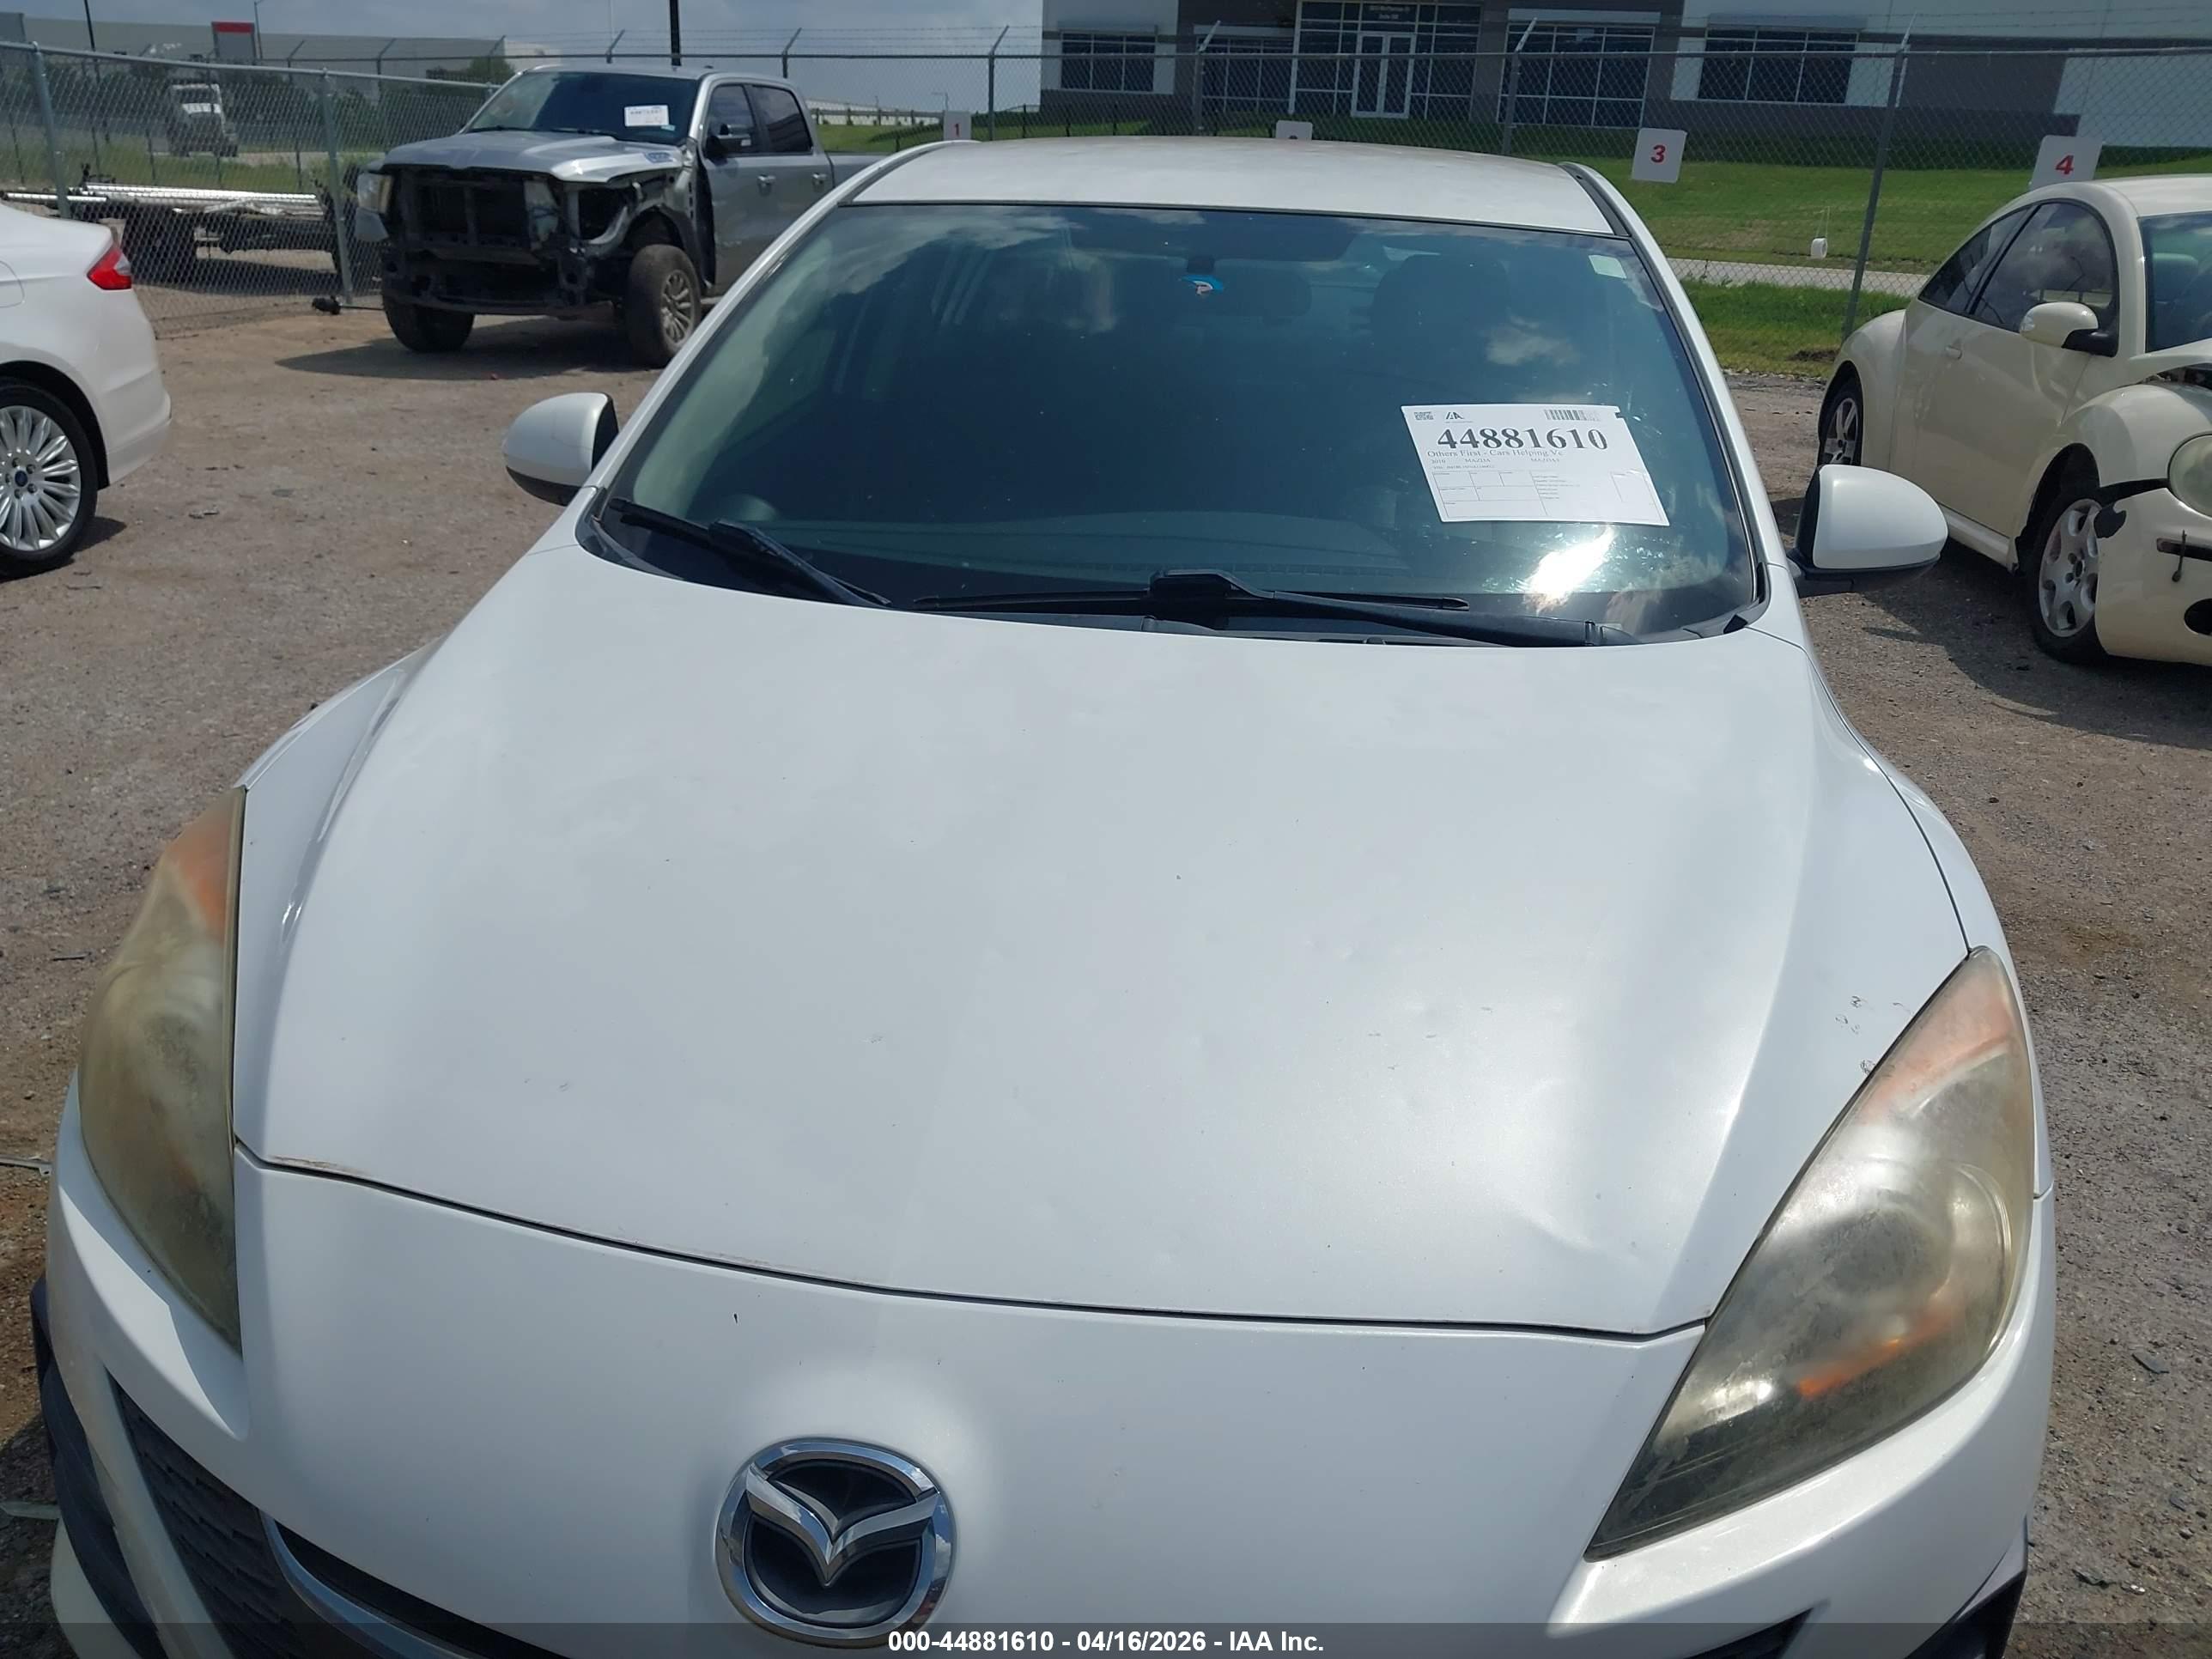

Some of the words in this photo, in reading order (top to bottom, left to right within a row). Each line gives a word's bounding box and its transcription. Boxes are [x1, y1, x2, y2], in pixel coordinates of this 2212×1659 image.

[953, 123, 960, 137] 1
[1650, 144, 1666, 163] 3
[2055, 155, 2075, 175] 4
[1437, 428, 1607, 450] 44881610
